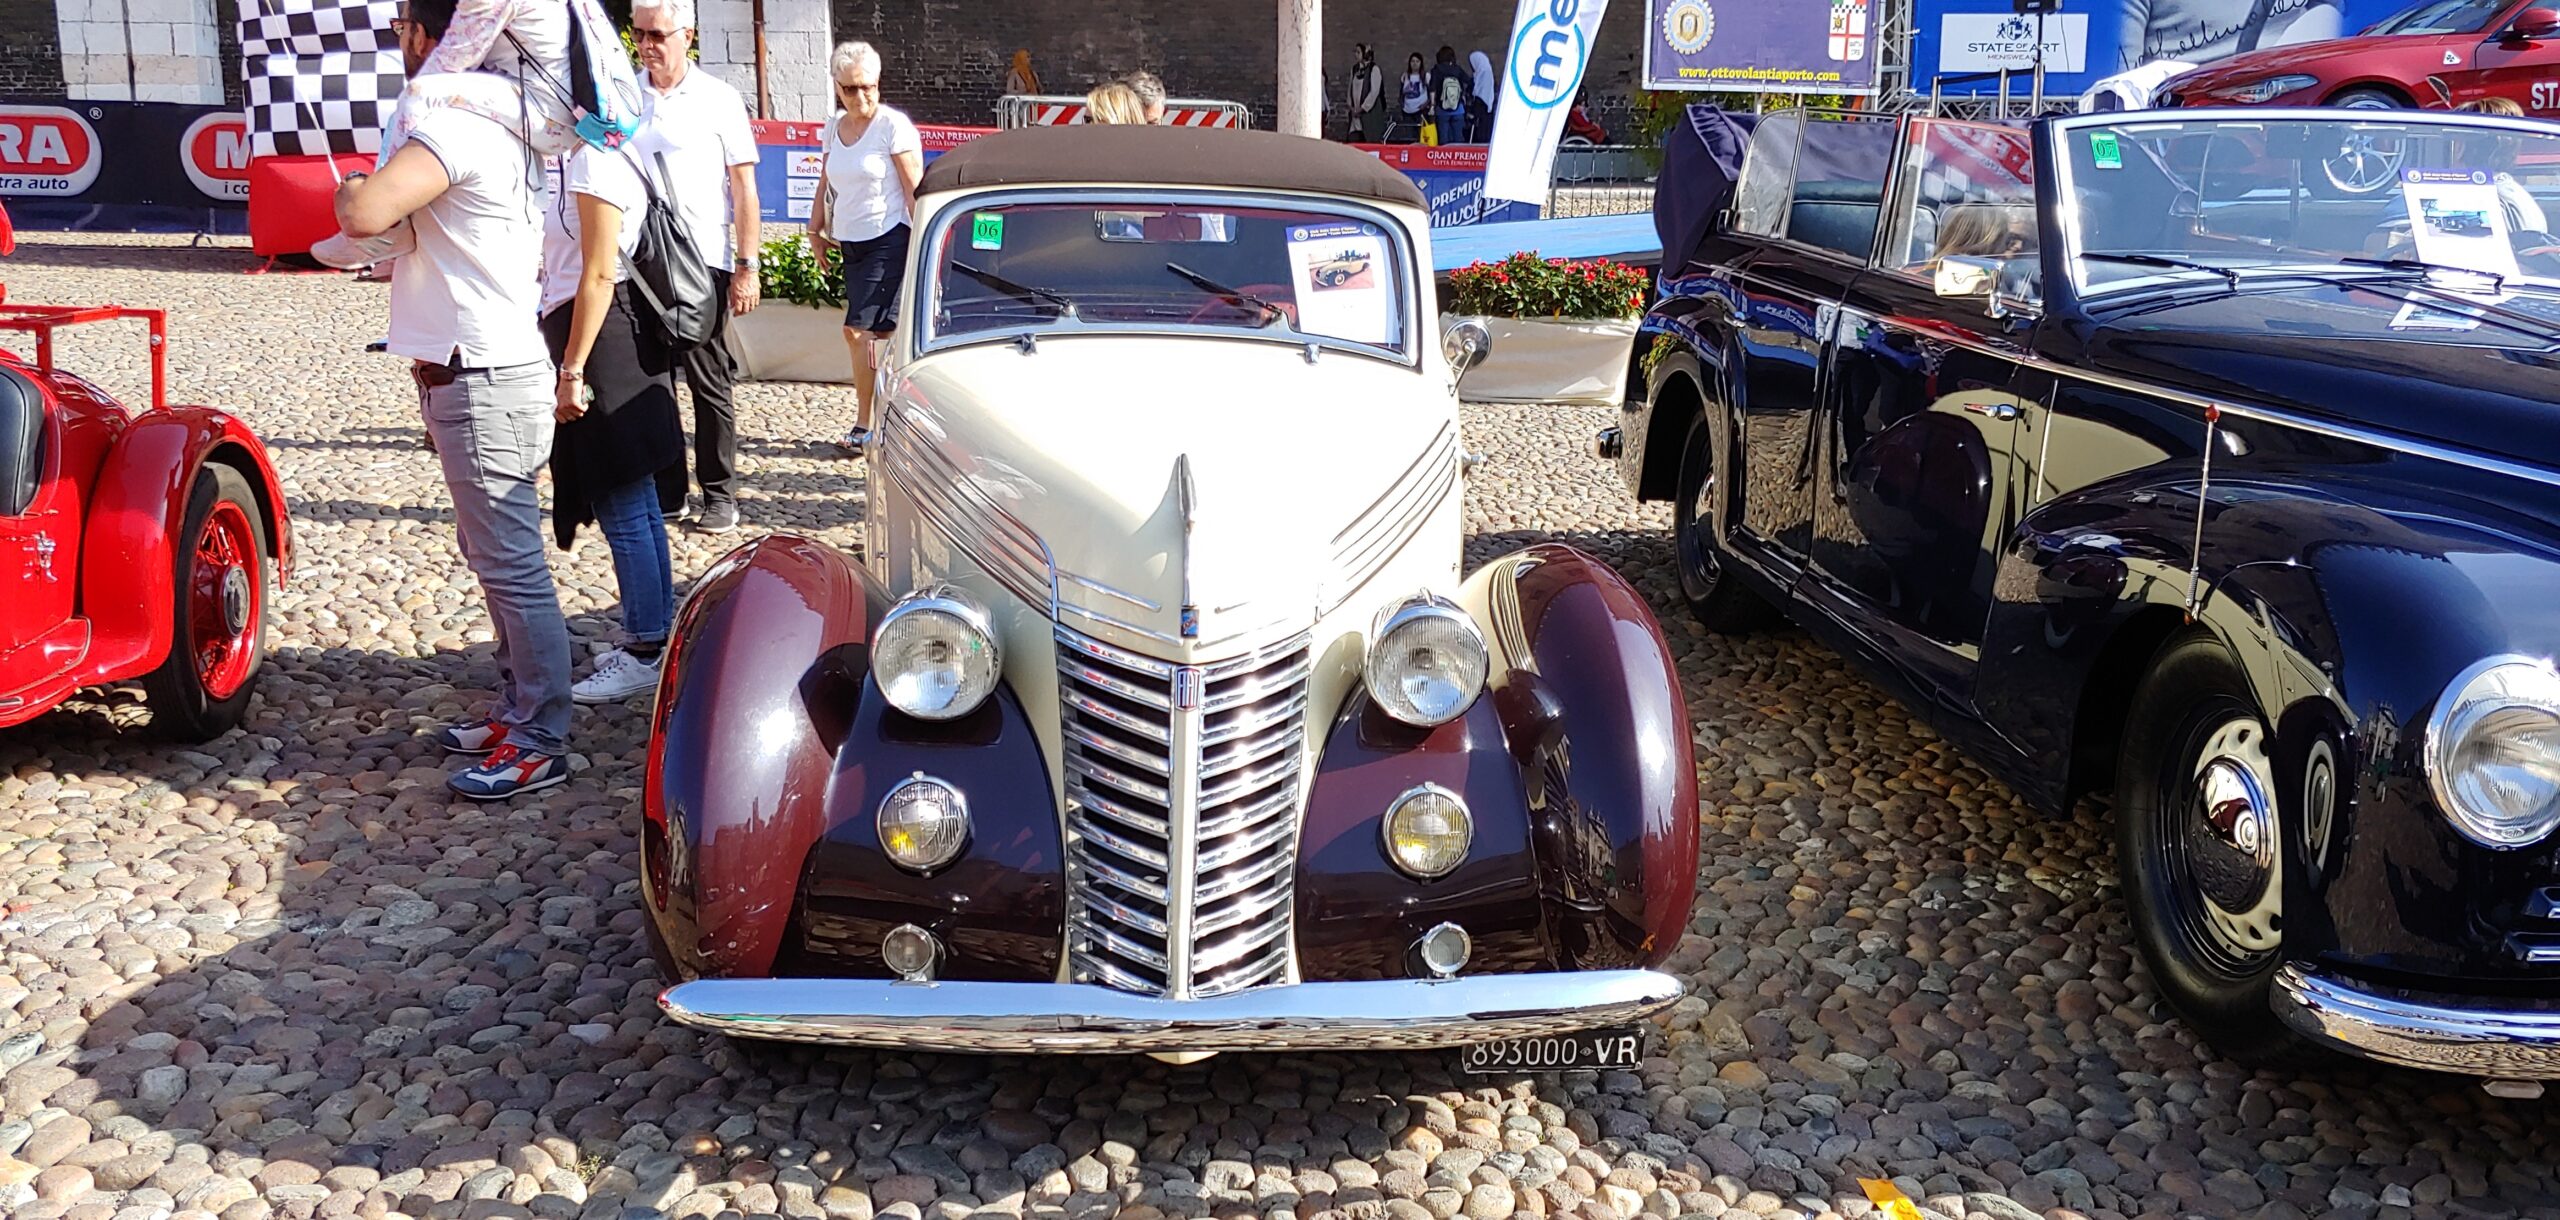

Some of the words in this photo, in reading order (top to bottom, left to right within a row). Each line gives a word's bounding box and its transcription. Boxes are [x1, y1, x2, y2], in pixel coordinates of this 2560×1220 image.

[1530, 0, 1579, 90] me
[1967, 42, 2014, 53] STATE
[2029, 42, 2060, 53] ART
[1678, 66, 1841, 83] www.ottovolantiaporto.com
[2531, 82, 2560, 110] ST
[920, 131, 945, 140] GRAN
[1427, 151, 1453, 160] GRAN
[1454, 152, 1488, 161] PREMIO
[2096, 142, 2115, 157] 07
[796, 166, 812, 174] Red
[28, 177, 69, 190] auto
[1431, 177, 1482, 211] PREMIO
[978, 222, 998, 238] 06
[1177, 670, 1200, 708] FIAT
[1472, 1039, 1578, 1066] 893000
[1594, 1036, 1637, 1065] VR
